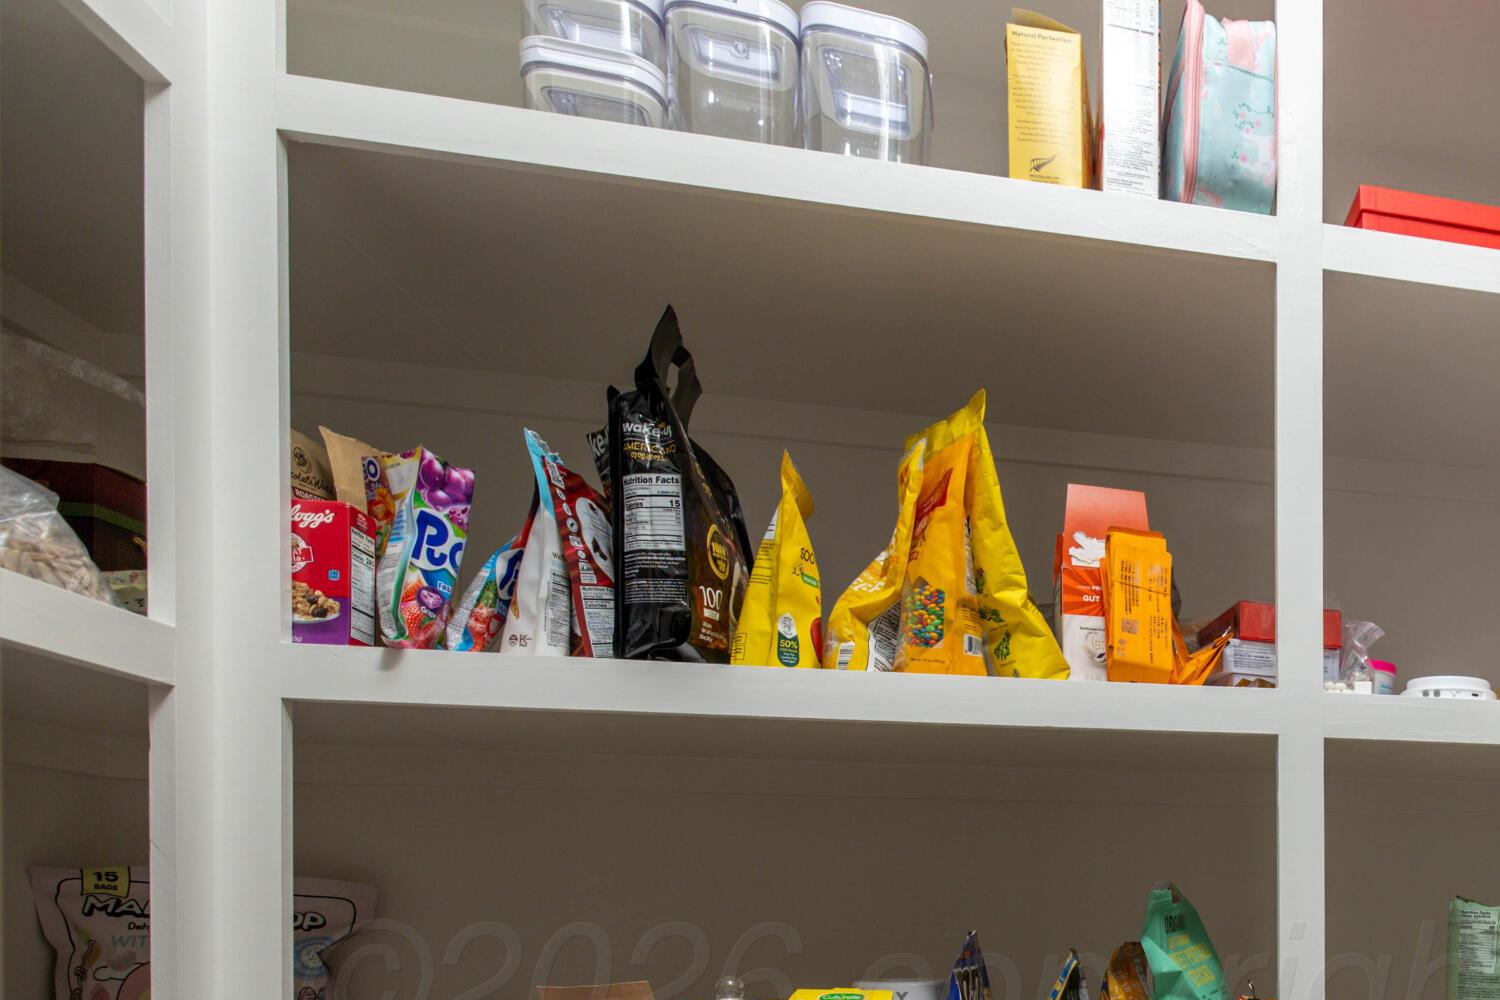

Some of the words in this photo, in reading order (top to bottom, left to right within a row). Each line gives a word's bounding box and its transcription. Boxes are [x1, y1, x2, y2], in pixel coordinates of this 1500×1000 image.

[655, 475, 681, 485] Facts
[669, 499, 681, 508] 15
[291, 506, 335, 530] logg's
[779, 638, 798, 649] 50%
[92, 871, 119, 883] 15
[94, 883, 118, 892] BAGS
